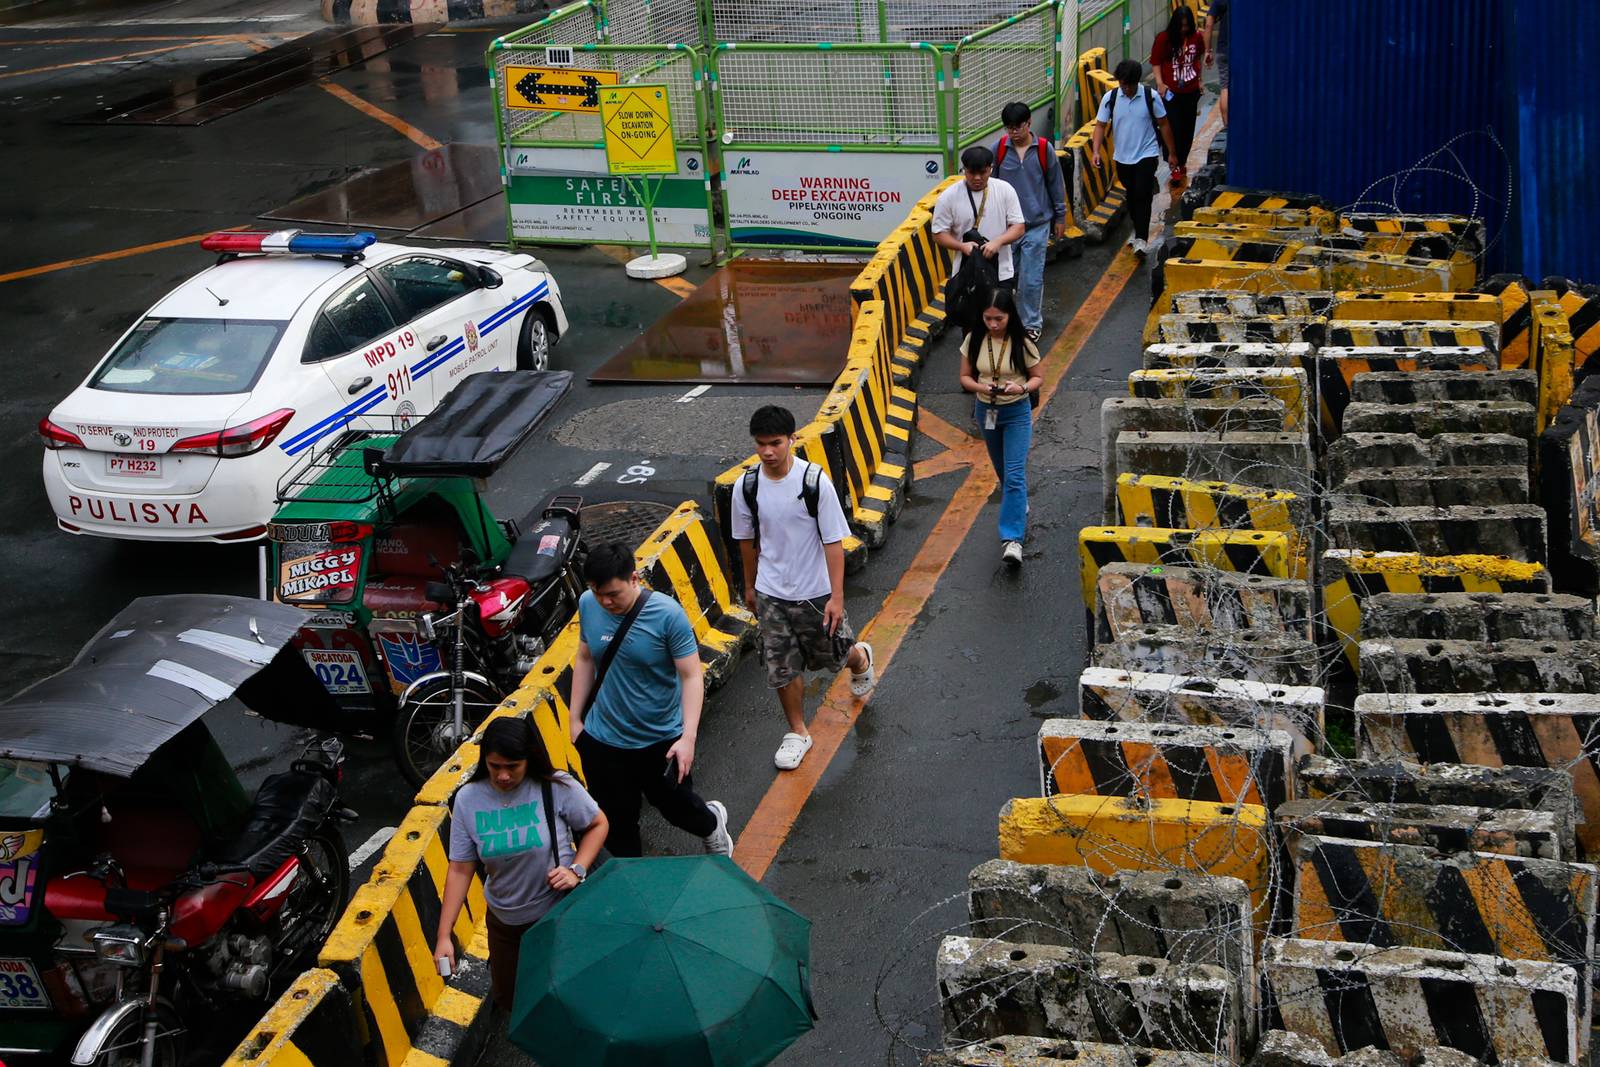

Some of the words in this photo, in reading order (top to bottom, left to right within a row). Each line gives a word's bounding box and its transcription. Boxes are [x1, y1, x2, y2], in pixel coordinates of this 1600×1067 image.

[618, 112, 634, 120] SLOW
[621, 130, 656, 139] ON-GOING
[566, 178, 643, 192] SAFE
[800, 177, 870, 190] WARNING
[772, 189, 807, 201] DEEP
[812, 190, 901, 202] EXCAVATION
[789, 202, 846, 211] PIPELAYING
[848, 204, 884, 212] WORKS
[814, 212, 861, 220] ONGOING
[364, 342, 396, 368] MPD
[398, 332, 414, 350] 19
[388, 364, 411, 400] 911
[76, 425, 86, 435] TO
[88, 426, 113, 436] SERVE
[134, 428, 146, 436] AND
[148, 428, 179, 438] PROTECT
[138, 440, 155, 451] 19
[111, 459, 123, 469] P7
[128, 460, 156, 471] H232
[69, 496, 208, 524] PULISYA
[289, 552, 356, 578] MIGGY
[282, 568, 354, 597] MIKAEL
[311, 653, 355, 663] SRCATODA
[316, 664, 363, 685] 024
[475, 800, 540, 834] DUNK
[480, 826, 543, 858] ZILLA
